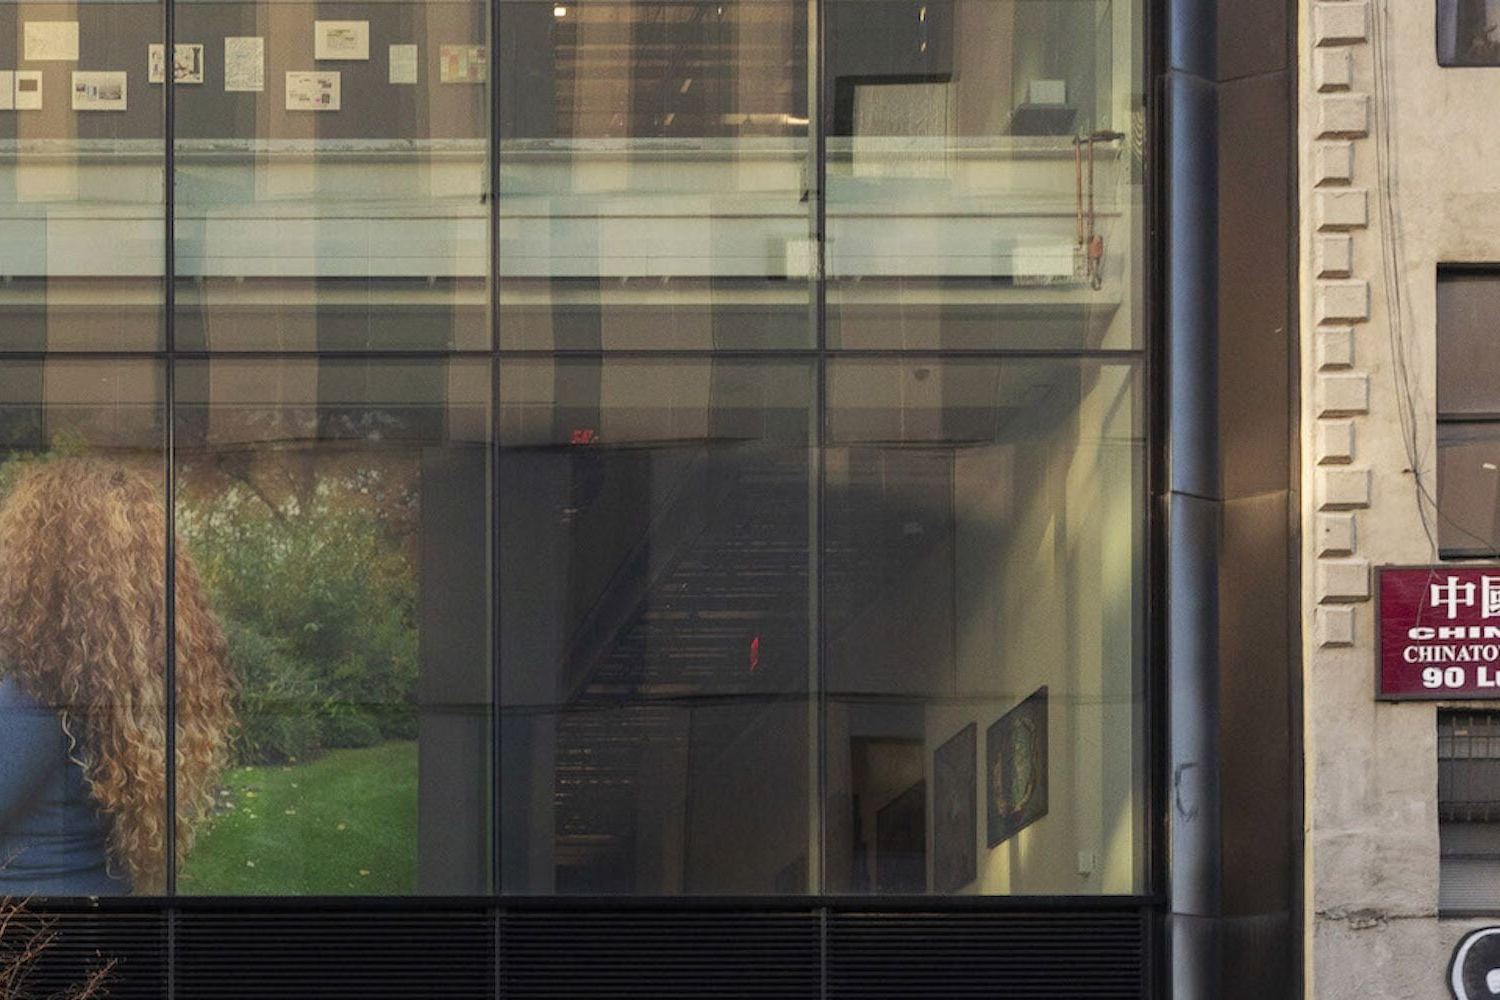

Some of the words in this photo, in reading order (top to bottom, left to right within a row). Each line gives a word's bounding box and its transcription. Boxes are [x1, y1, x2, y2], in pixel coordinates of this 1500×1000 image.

[1403, 645, 1500, 662] CHINATO
[1422, 667, 1465, 688] 90
[1477, 666, 1500, 688] L
